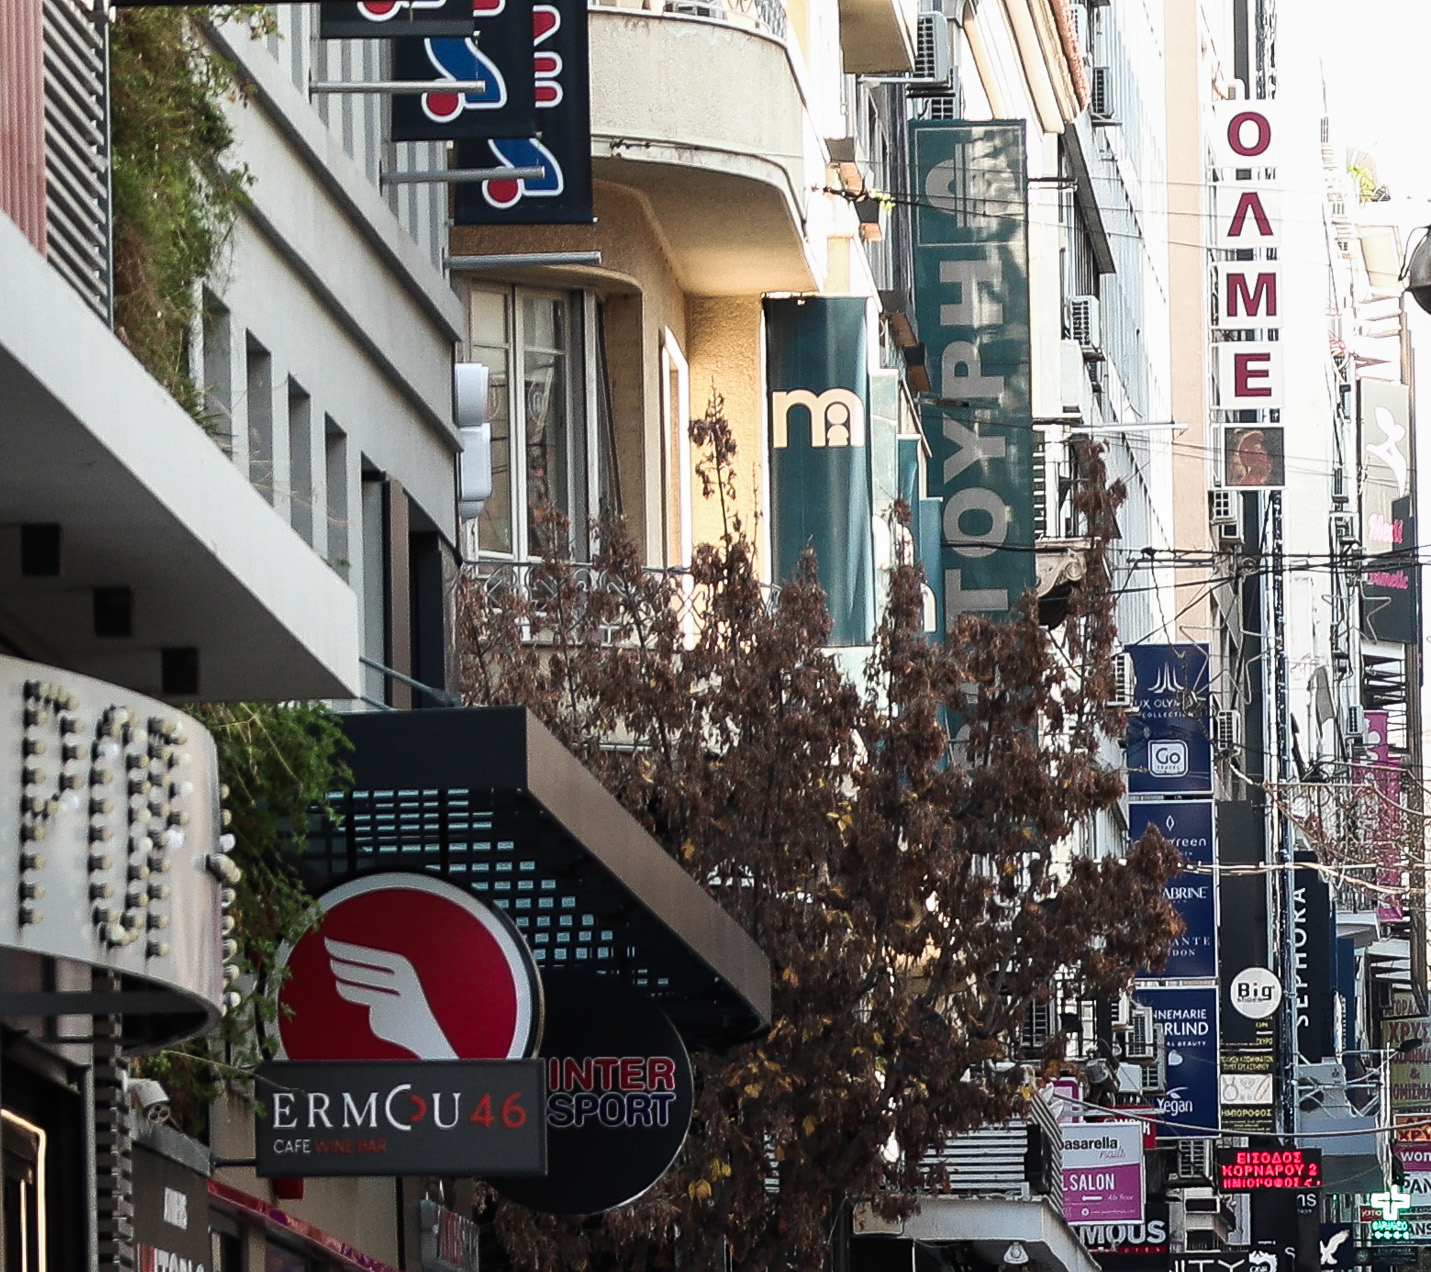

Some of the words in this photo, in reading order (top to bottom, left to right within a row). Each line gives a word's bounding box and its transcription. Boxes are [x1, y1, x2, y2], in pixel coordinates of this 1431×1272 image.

[1237, 982, 1274, 1000] Big
[548, 1056, 676, 1091] INTER
[470, 1092, 527, 1130] 46
[547, 1093, 676, 1129] SPORT
[273, 1139, 312, 1154] CAFE
[314, 1139, 354, 1154] WINE
[356, 1139, 388, 1154] BAR
[1236, 1151, 1302, 1164] ΕΙΣΟΔΟΣ
[1222, 1164, 1304, 1176] ΚΟΡΝΑΡΟΥ
[1069, 1173, 1115, 1191] SALON
